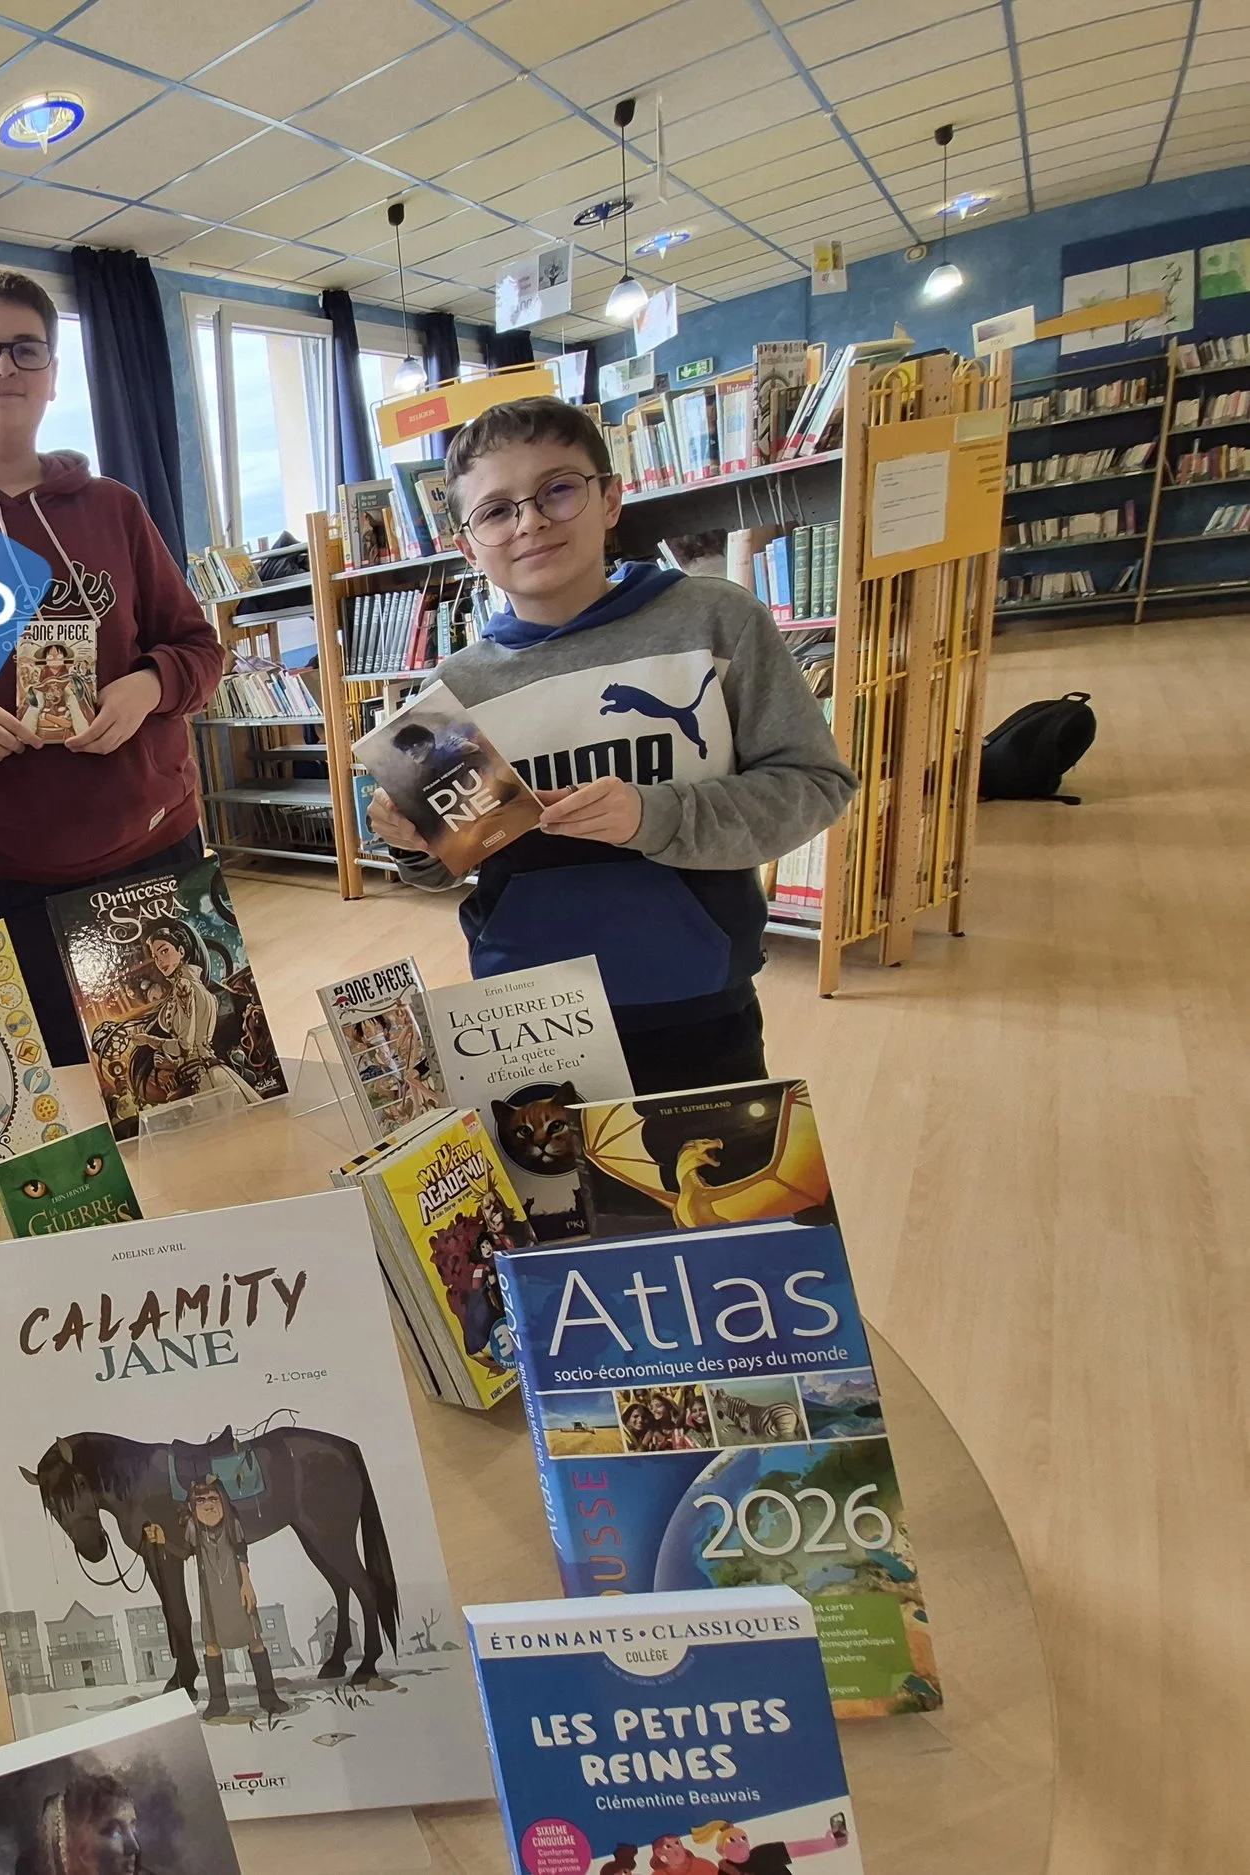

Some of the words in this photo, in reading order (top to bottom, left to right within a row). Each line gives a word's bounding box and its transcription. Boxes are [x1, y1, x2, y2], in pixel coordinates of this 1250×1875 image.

[32, 624, 54, 641] ONE
[427, 768, 483, 816] DU
[442, 787, 502, 833] NE
[89, 879, 179, 919] Princesse
[107, 895, 191, 944] SARA
[345, 976, 376, 1006] ONE
[484, 986, 504, 997] Erin
[504, 980, 536, 993] Hunter
[477, 997, 548, 1023] GUERRE
[549, 989, 585, 1008] DES
[452, 1006, 595, 1057] CLANS
[501, 1053, 519, 1065] La
[521, 1046, 557, 1065] quête
[487, 1064, 536, 1084] d'Étoile
[538, 1061, 554, 1074] de
[556, 1058, 581, 1071] Feu
[659, 1107, 673, 1116] TUI
[682, 1100, 732, 1114] SUTHERLAND
[417, 1159, 443, 1188] MY
[27, 1193, 118, 1237] GUERRE
[110, 1246, 156, 1262] ADELINE
[156, 1241, 187, 1256] AVRIL
[547, 1254, 840, 1358] Atlas
[94, 1328, 240, 1383] JANE
[553, 1357, 694, 1384] socio-économique
[696, 1356, 725, 1373] des
[727, 1354, 764, 1377] pays
[765, 1350, 788, 1367] du
[790, 1345, 849, 1366] monde
[281, 1366, 328, 1383] L'Orage
[692, 1483, 895, 1561] 2026
[825, 1603, 855, 1612] cartes
[490, 1625, 634, 1651] ÉTONNANTS
[651, 1615, 801, 1641] CLASSIQUES
[625, 1648, 669, 1664] COLLÈGE
[531, 1711, 598, 1748] LES
[614, 1697, 792, 1742] PETITES
[580, 1743, 739, 1788] REINES
[595, 1791, 686, 1811] Clémentine
[689, 1786, 761, 1806] Beauvais
[532, 1835, 576, 1848] CINQUIÈME
[535, 1824, 568, 1837] SIXIÈME
[537, 1848, 575, 1857] Conforme
